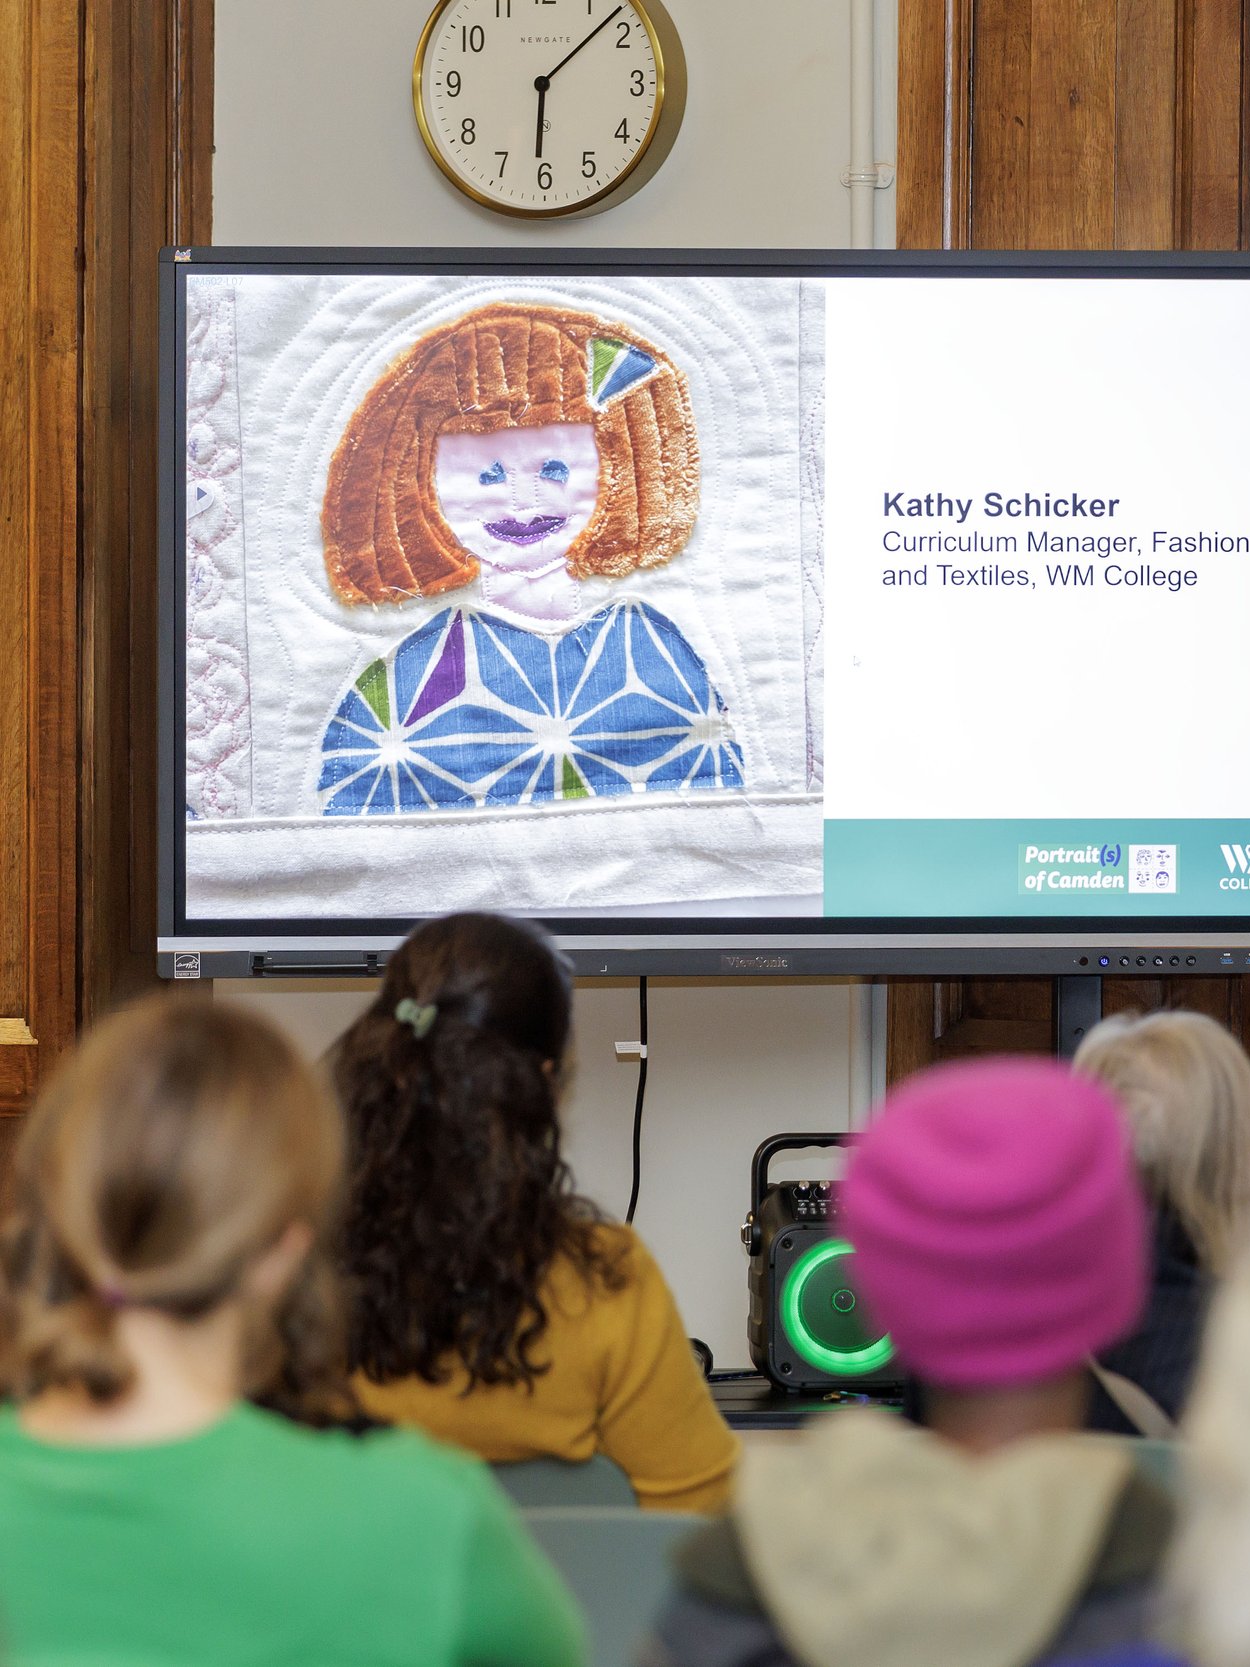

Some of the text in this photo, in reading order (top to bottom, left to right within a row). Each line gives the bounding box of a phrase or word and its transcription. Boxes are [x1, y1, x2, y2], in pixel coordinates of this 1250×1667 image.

[462, 25, 485, 53] 10
[520, 36, 571, 44] NEWGATE
[615, 22, 631, 49] 2
[446, 70, 462, 98] 9
[629, 69, 645, 97] 3
[460, 118, 476, 146] 8
[614, 117, 631, 145] 4
[494, 151, 509, 178] 7
[537, 162, 553, 190] 6
[581, 151, 597, 179] 5
[884, 492, 1121, 523] Kathy Schicker
[883, 530, 1250, 558] Curriculum Manager, Fashion
[882, 564, 1198, 592] and Textiles, WM College
[1024, 844, 1121, 867] Portrait(s)
[1024, 870, 1125, 892] of Camden
